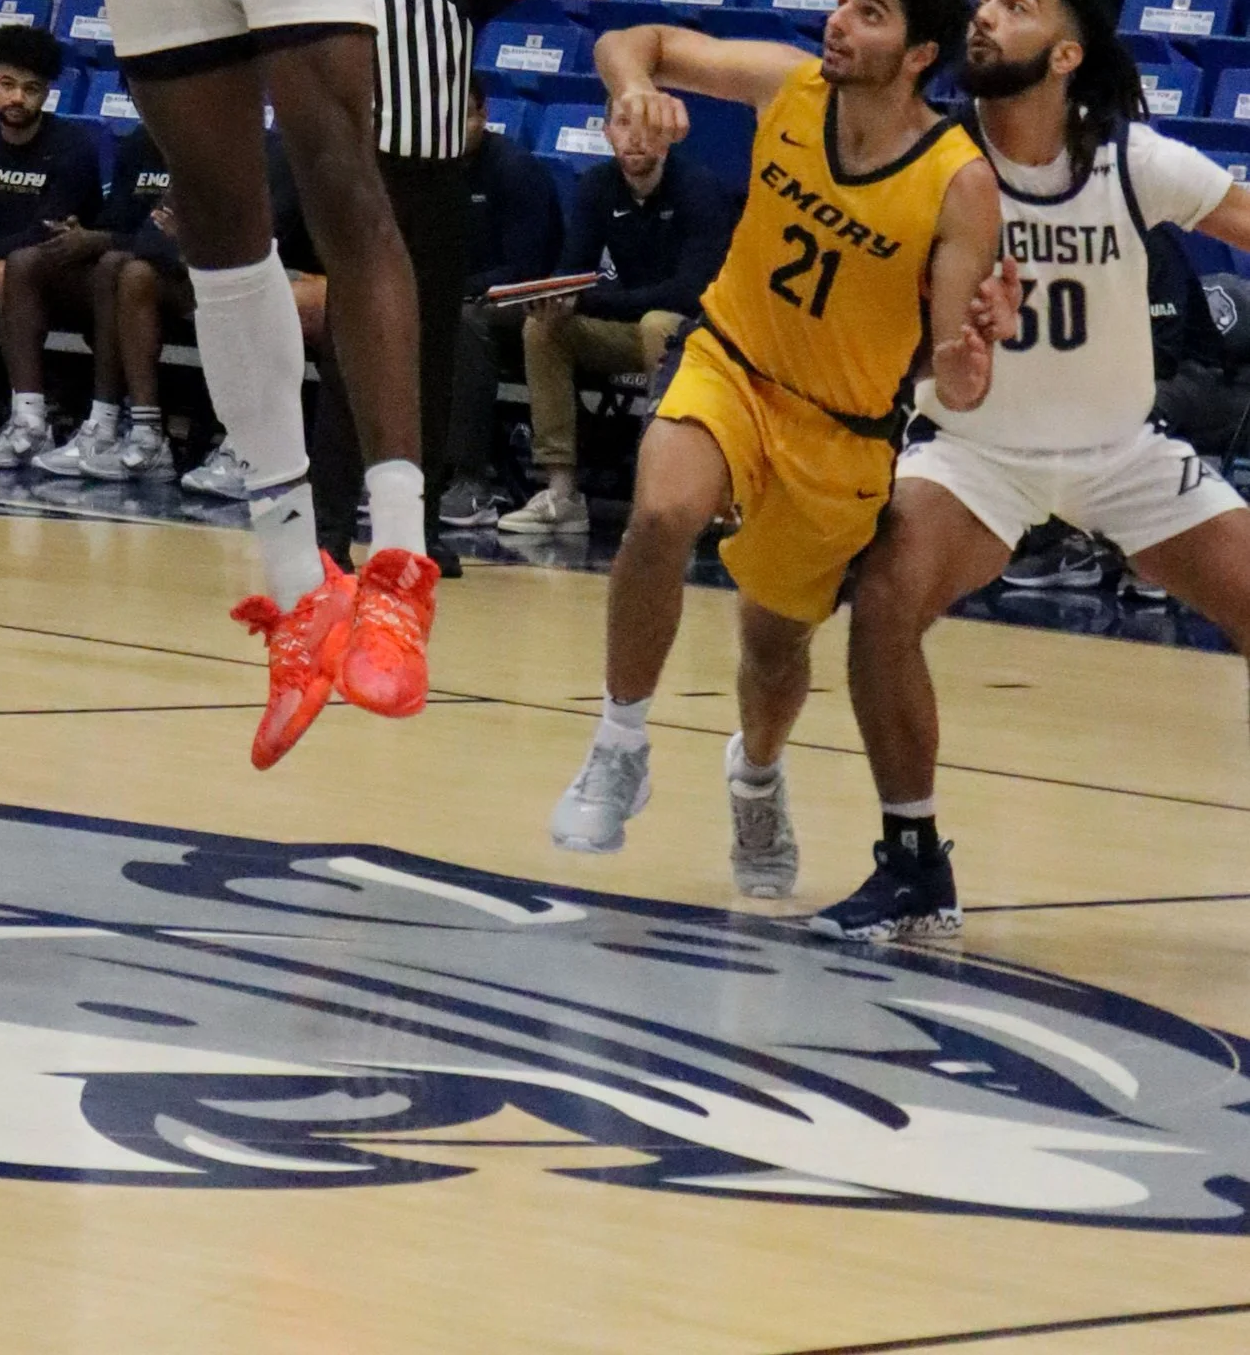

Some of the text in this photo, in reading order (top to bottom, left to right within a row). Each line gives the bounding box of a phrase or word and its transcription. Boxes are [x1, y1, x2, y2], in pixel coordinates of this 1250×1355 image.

[760, 162, 902, 259] EMORY
[769, 224, 842, 320] 21
[1000, 278, 1088, 352] 30
